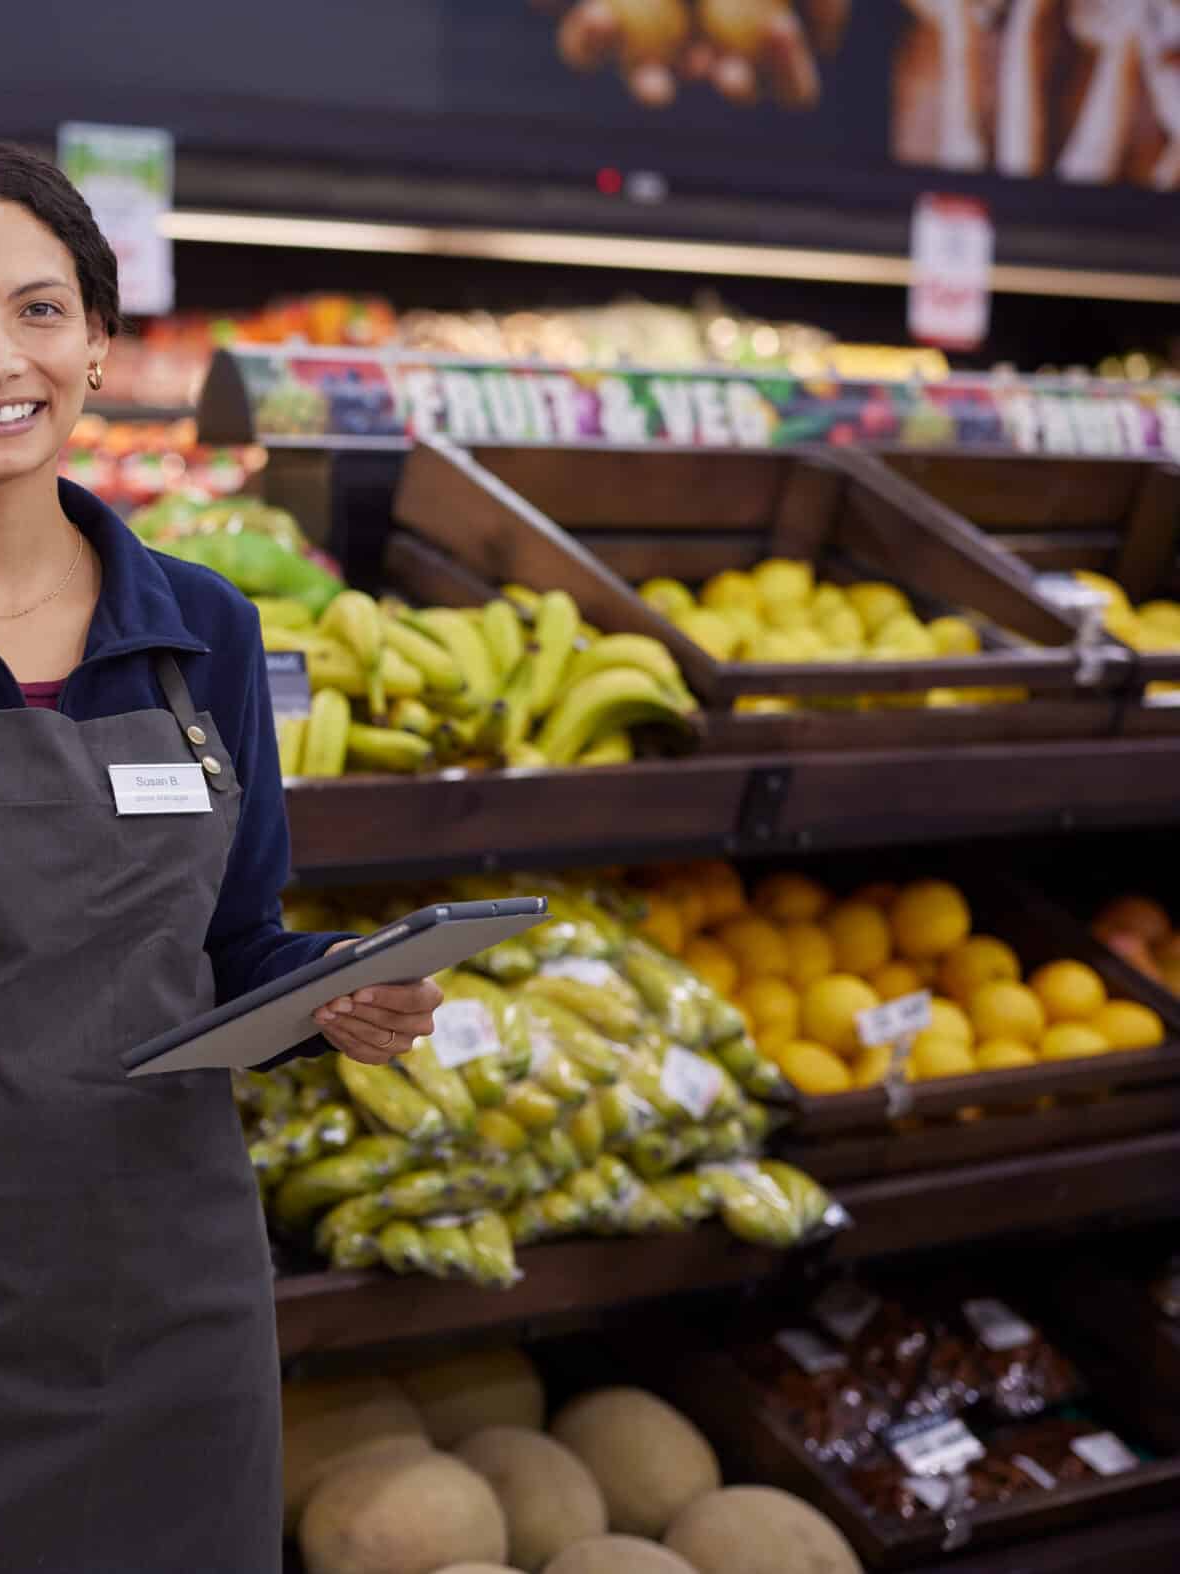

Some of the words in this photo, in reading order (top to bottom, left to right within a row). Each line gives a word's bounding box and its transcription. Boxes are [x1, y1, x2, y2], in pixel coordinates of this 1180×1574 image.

[406, 367, 577, 441] FRUIT
[598, 375, 649, 442] &
[651, 378, 773, 447] VEG
[135, 776, 168, 788] Susan
